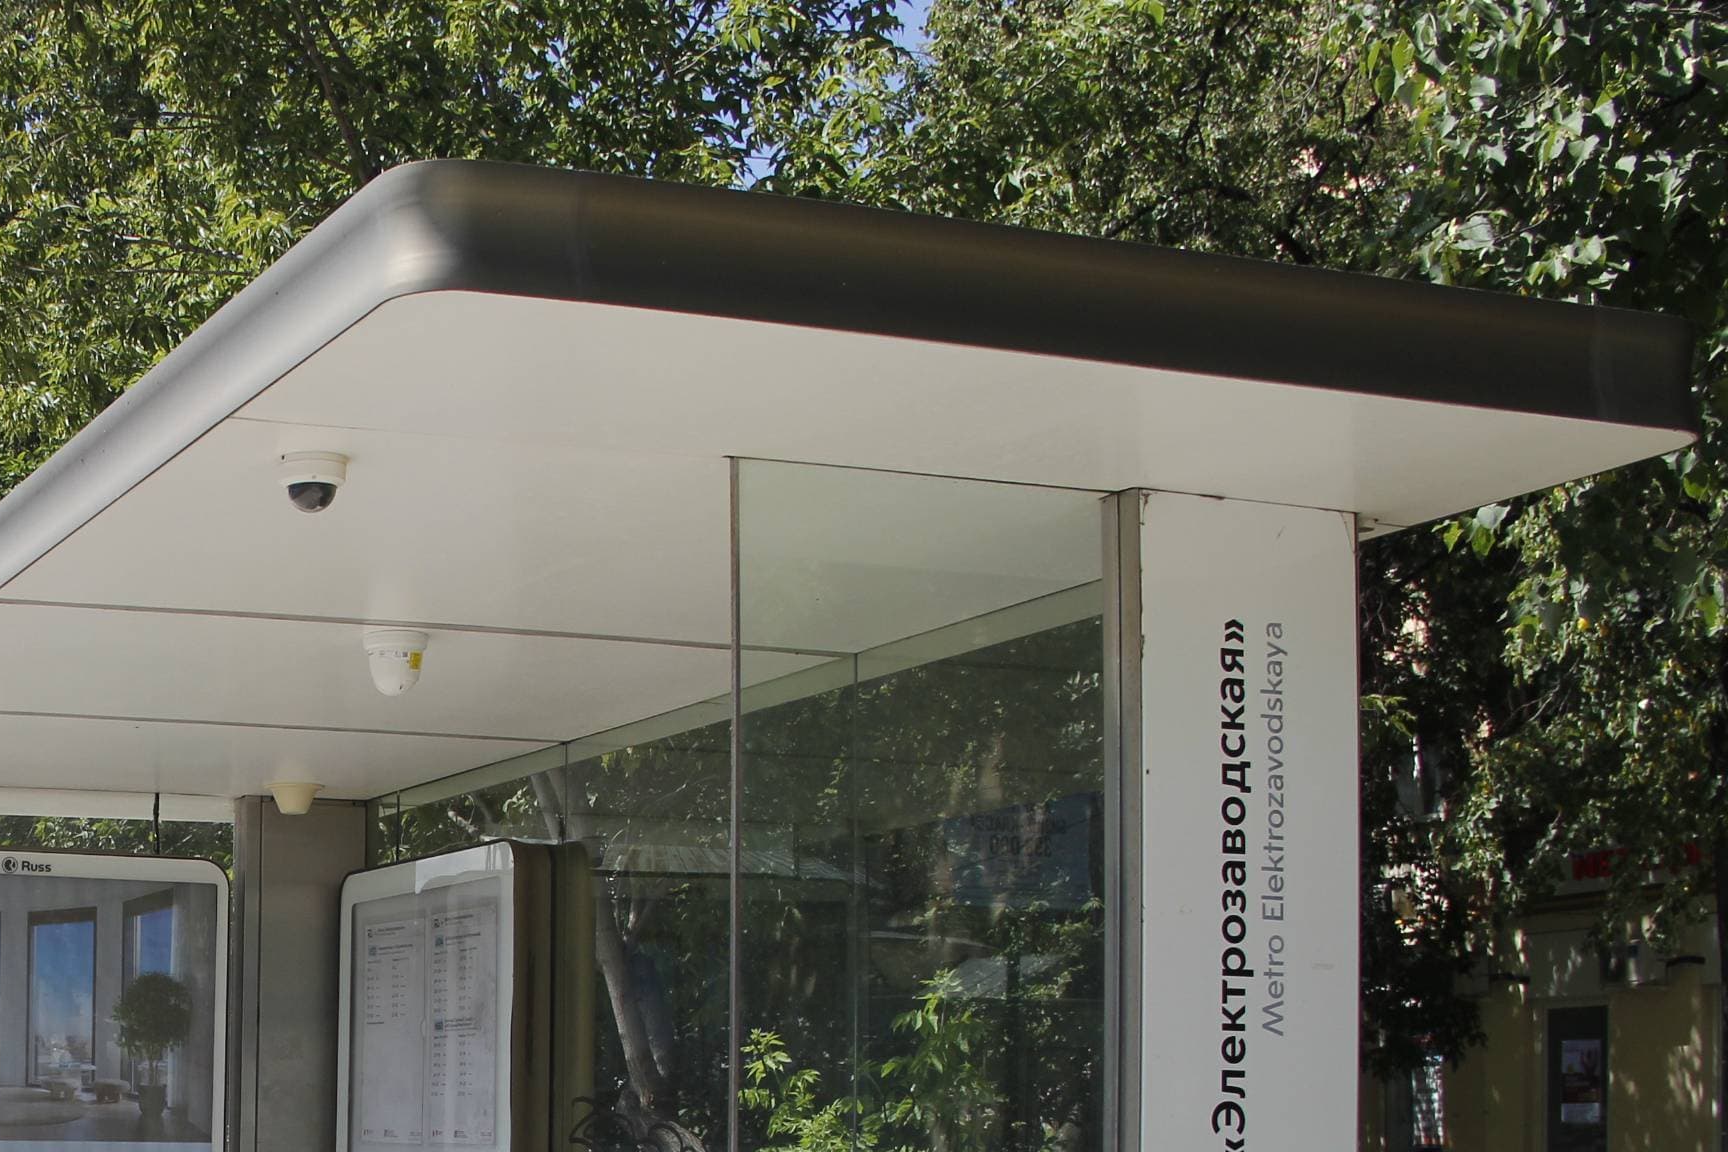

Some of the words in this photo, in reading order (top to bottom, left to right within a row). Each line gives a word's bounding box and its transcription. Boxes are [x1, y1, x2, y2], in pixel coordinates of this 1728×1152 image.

[1260, 621, 1284, 922] Elektrozavodskaya
[21, 861, 52, 873] Russ
[1260, 935, 1285, 1037] Metro
